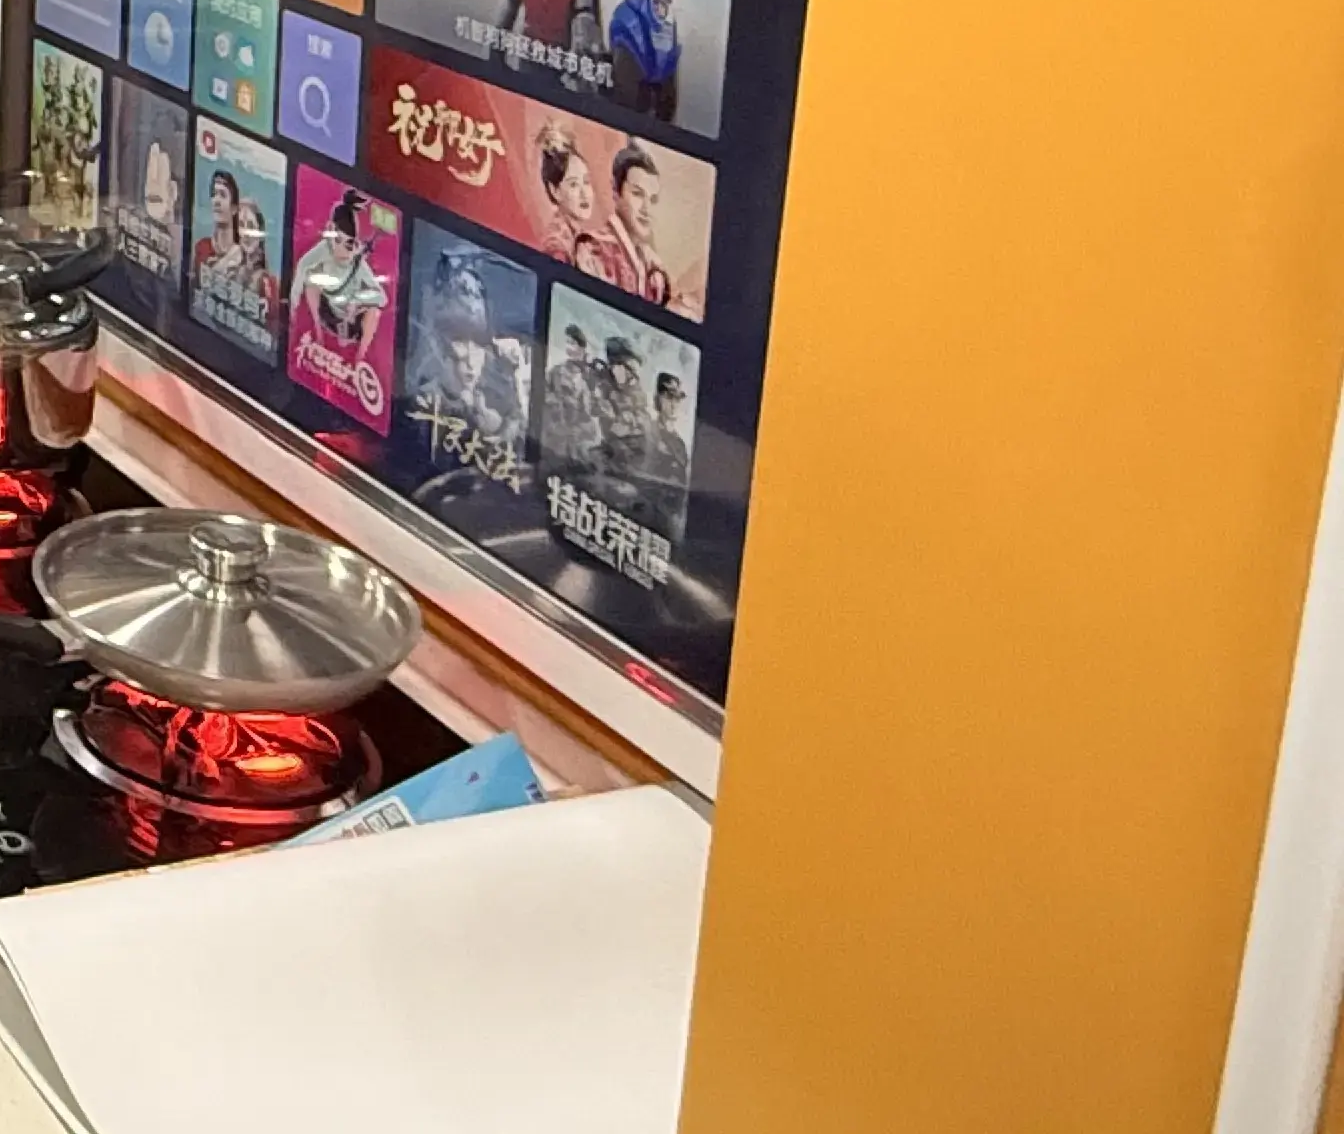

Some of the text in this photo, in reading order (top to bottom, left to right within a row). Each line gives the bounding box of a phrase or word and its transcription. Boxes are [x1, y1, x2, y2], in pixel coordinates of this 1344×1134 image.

[387, 83, 506, 188] 祝卿好
[546, 475, 673, 585] 特战荣耀
